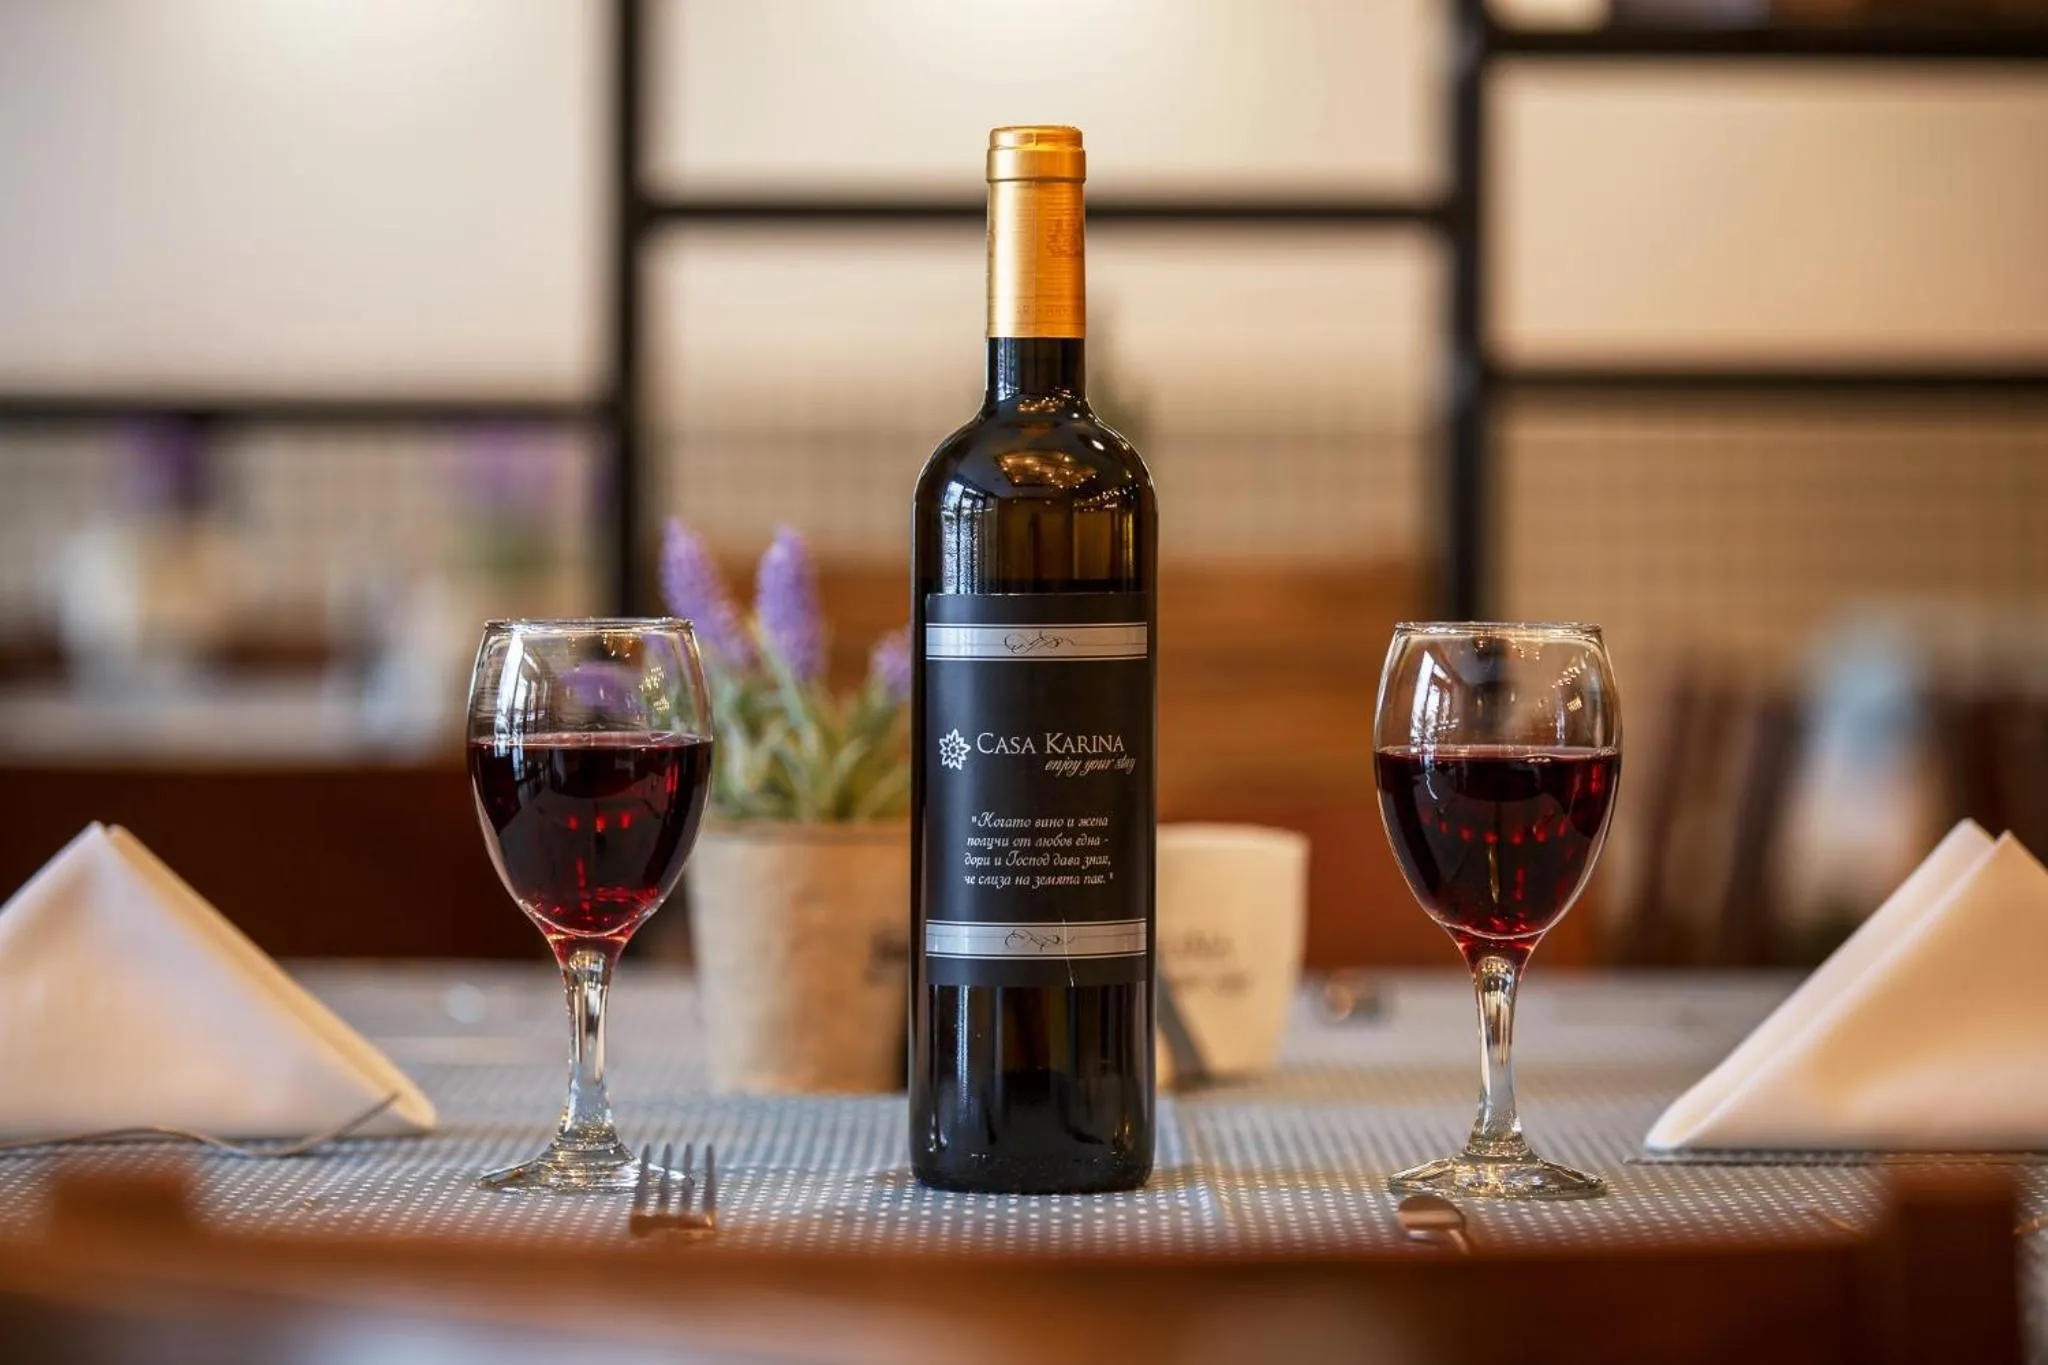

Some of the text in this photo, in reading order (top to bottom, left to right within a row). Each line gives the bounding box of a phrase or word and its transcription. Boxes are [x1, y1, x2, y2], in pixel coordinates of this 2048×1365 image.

[977, 732, 1125, 754] CASA KARINA
[1045, 756, 1083, 778] enjoy
[1081, 758, 1114, 776] your
[971, 811, 1108, 828] "Когато вино и жена
[966, 837, 1009, 850] получи
[1012, 837, 1031, 847] от
[1035, 832, 1072, 847] любов
[964, 852, 991, 868] дори
[994, 856, 1002, 866] и
[1005, 850, 1050, 866] Господ
[1053, 853, 1080, 866] дава
[963, 875, 975, 885] че
[978, 875, 1011, 889] слиза
[1014, 875, 1030, 885] на
[1032, 874, 1080, 889] земята
